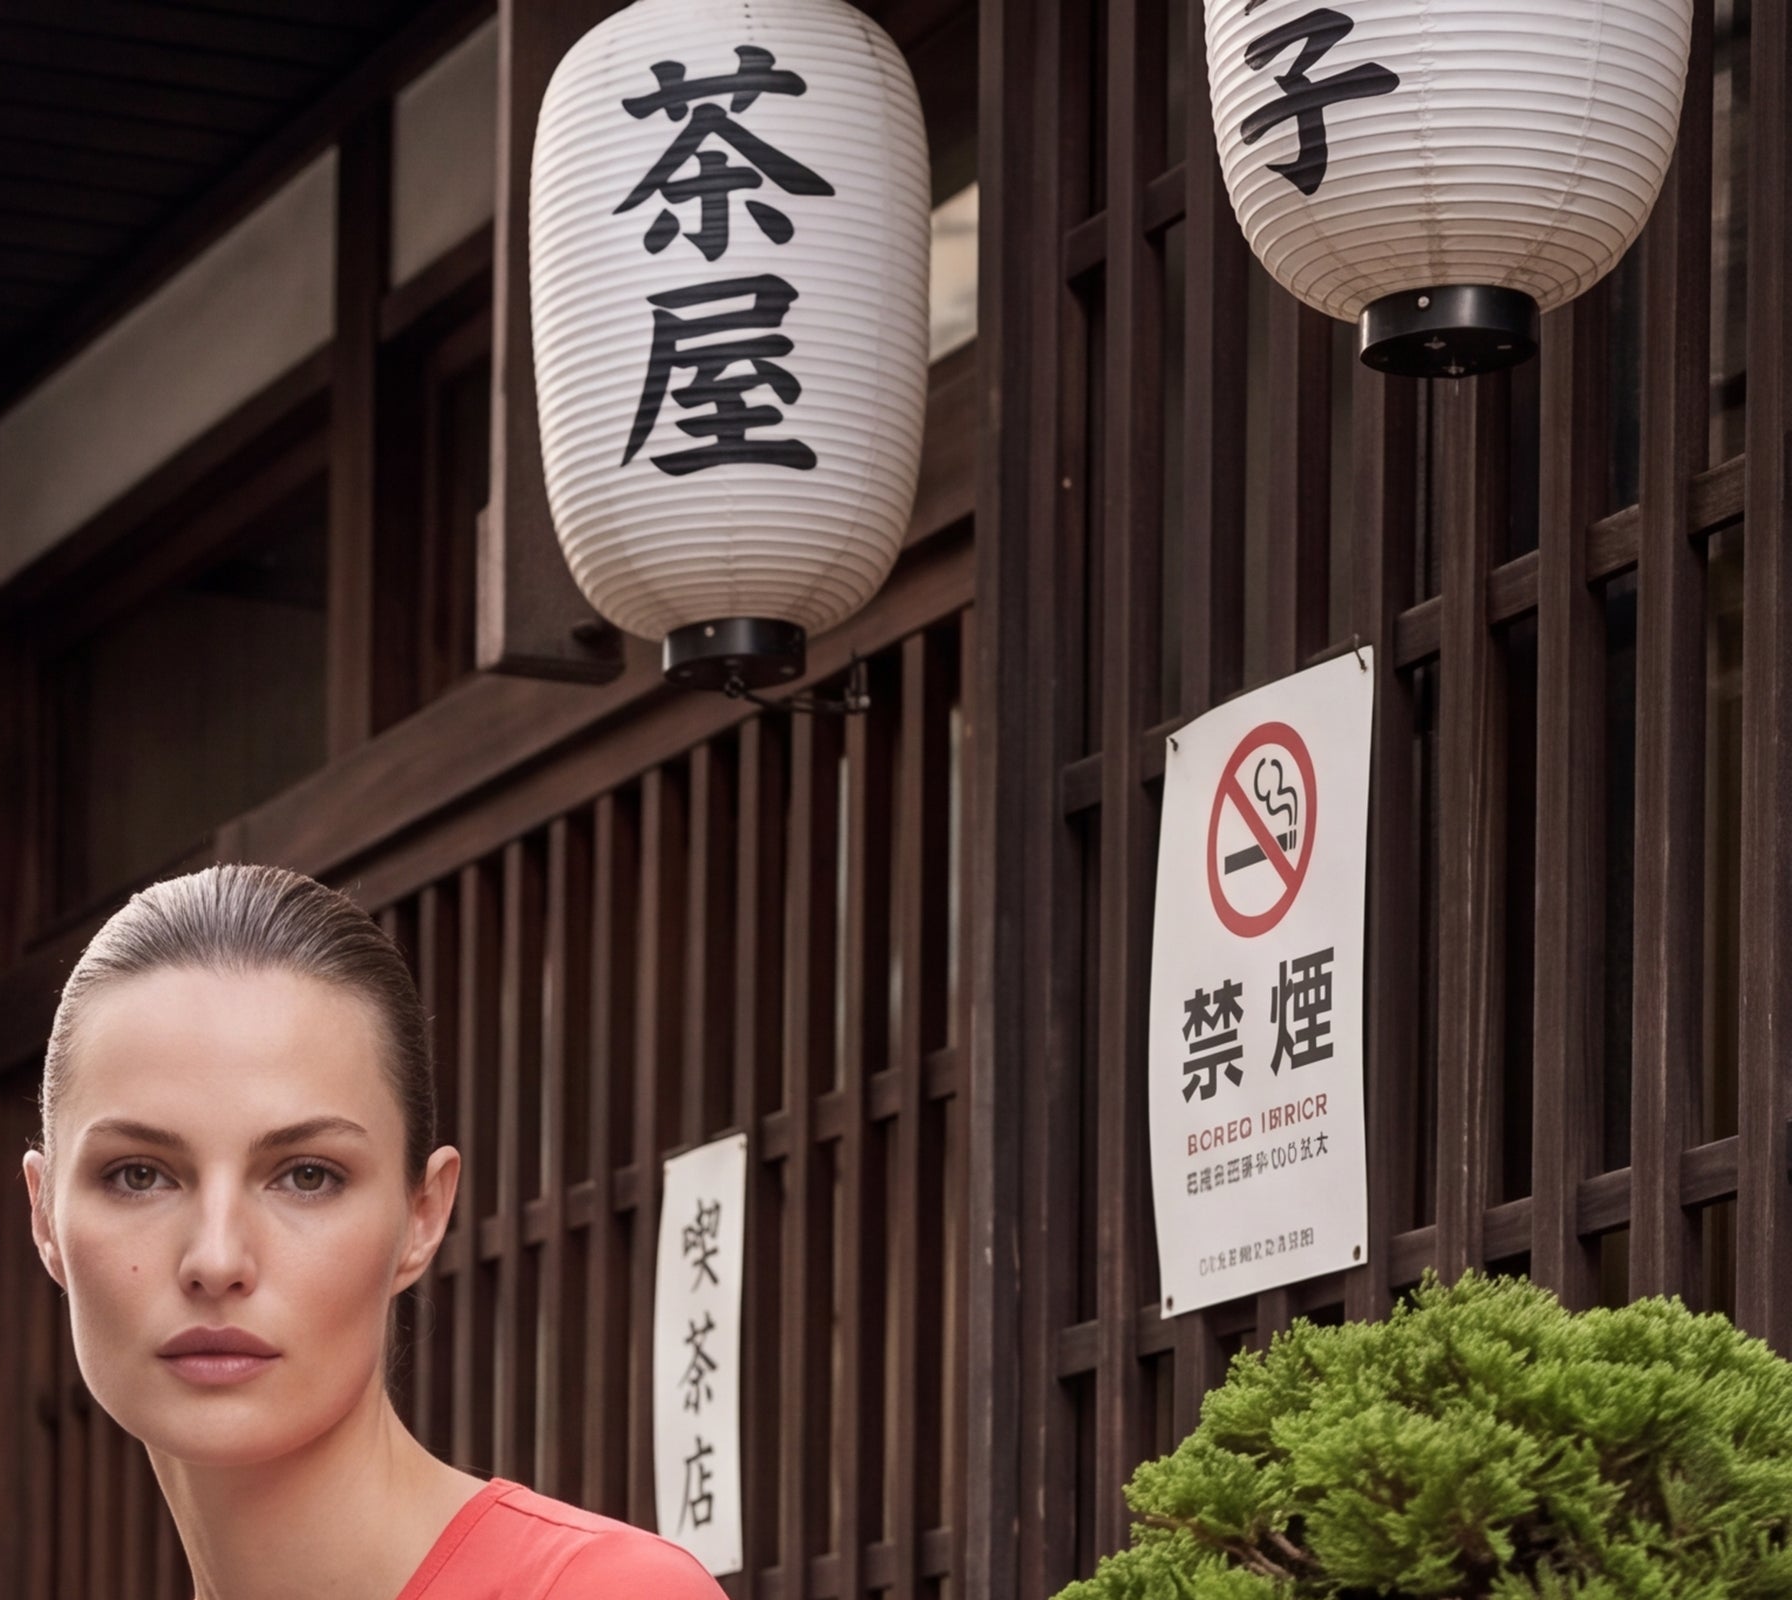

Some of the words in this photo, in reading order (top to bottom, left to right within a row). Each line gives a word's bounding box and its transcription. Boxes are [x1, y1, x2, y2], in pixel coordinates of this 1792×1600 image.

[1240, 0, 1400, 196] 子
[612, 45, 836, 477] 茶屋
[1182, 945, 1335, 1104] 禁煙
